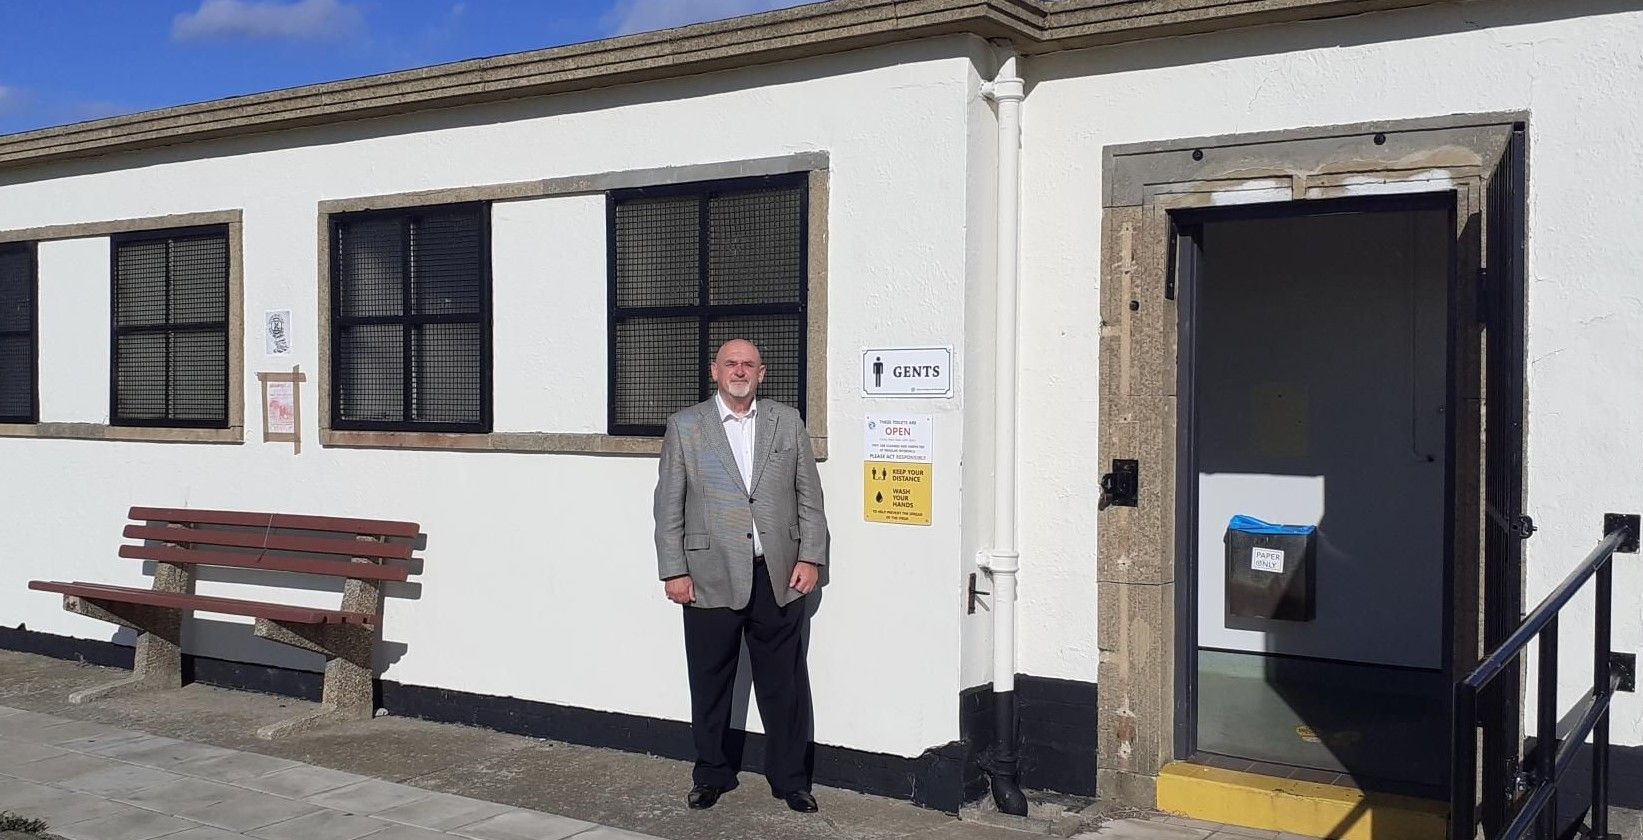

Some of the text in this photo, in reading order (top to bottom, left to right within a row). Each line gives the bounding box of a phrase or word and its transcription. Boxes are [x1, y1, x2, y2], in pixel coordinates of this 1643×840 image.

[893, 365, 940, 378] GENTS
[885, 426, 911, 436] OPEN
[892, 475, 921, 483] DISTANCE
[1256, 551, 1280, 560] PAPER
